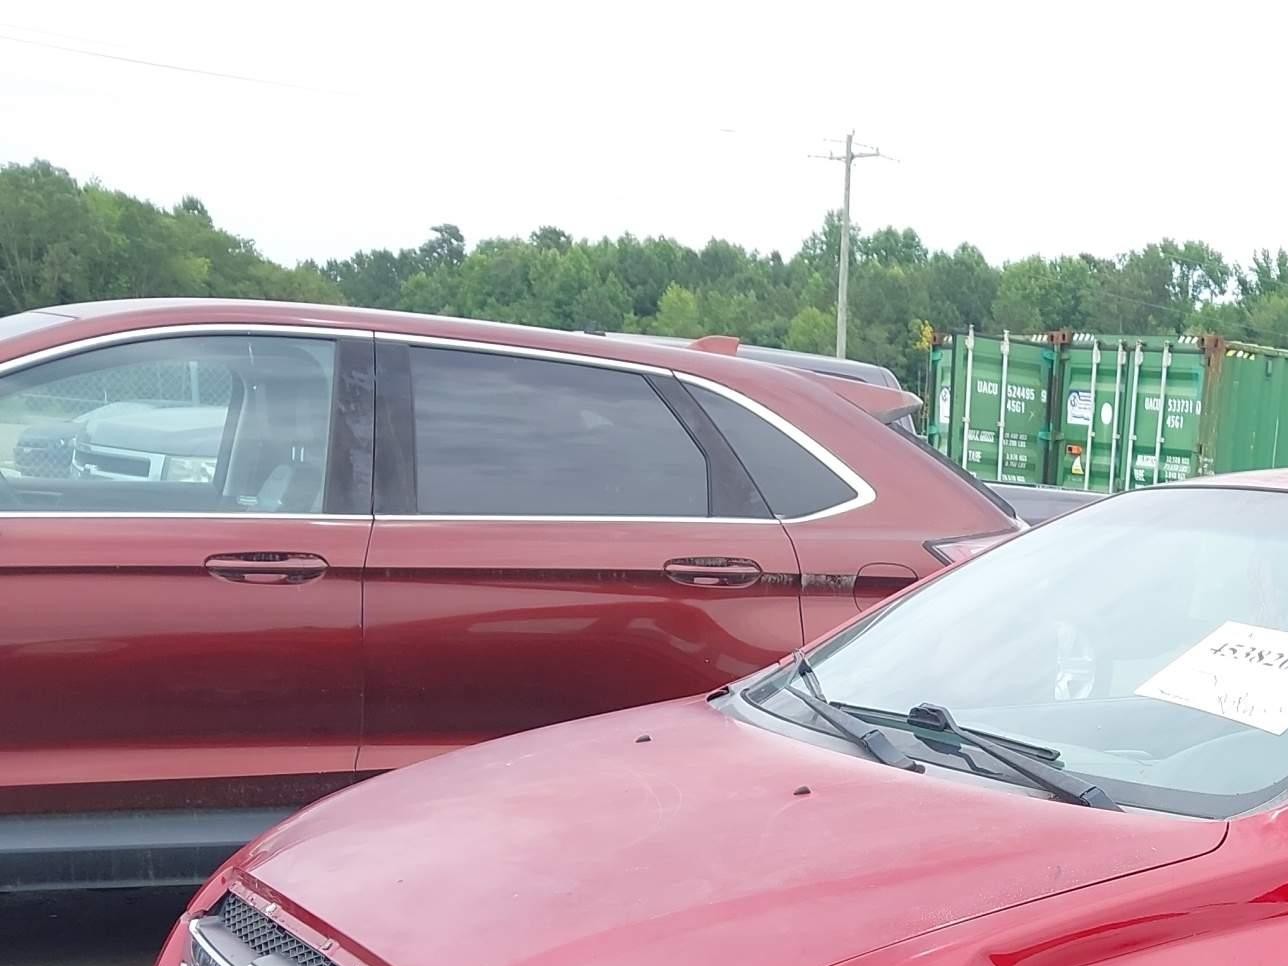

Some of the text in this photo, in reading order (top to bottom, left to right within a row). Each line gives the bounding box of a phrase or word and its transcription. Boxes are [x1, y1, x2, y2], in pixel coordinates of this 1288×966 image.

[977, 380, 1047, 402] UACU 524495 9
[1007, 400, 1025, 413] 45G1
[1168, 398, 1193, 413] 533731
[1166, 415, 1183, 429] 45G1
